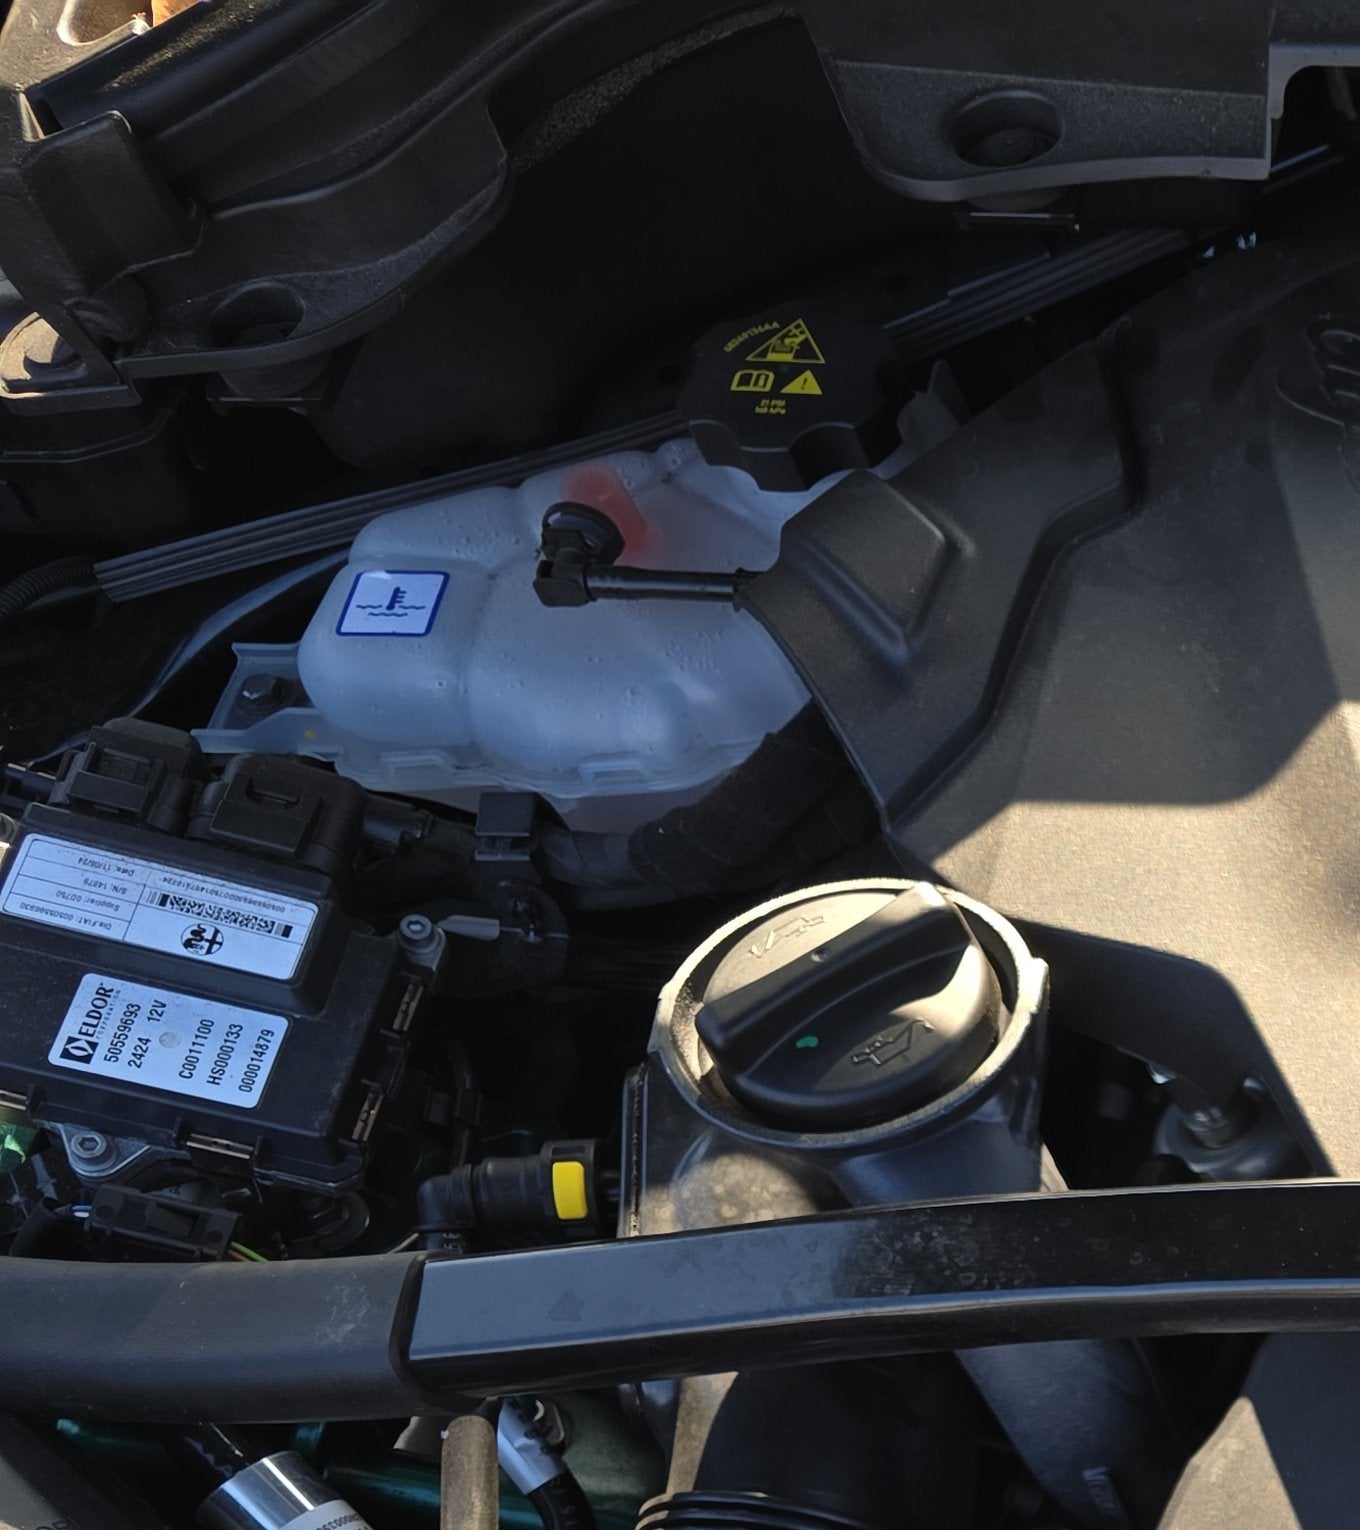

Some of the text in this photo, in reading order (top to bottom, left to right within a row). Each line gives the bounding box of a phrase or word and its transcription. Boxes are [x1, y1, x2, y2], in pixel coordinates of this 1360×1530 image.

[78, 986, 114, 1038] ELDOR
[103, 1002, 141, 1063] 50559693
[128, 999, 167, 1069] 2424 12V
[178, 1018, 215, 1080] C0011100
[206, 1023, 244, 1086] HS000133
[238, 1028, 275, 1093] 000014879
